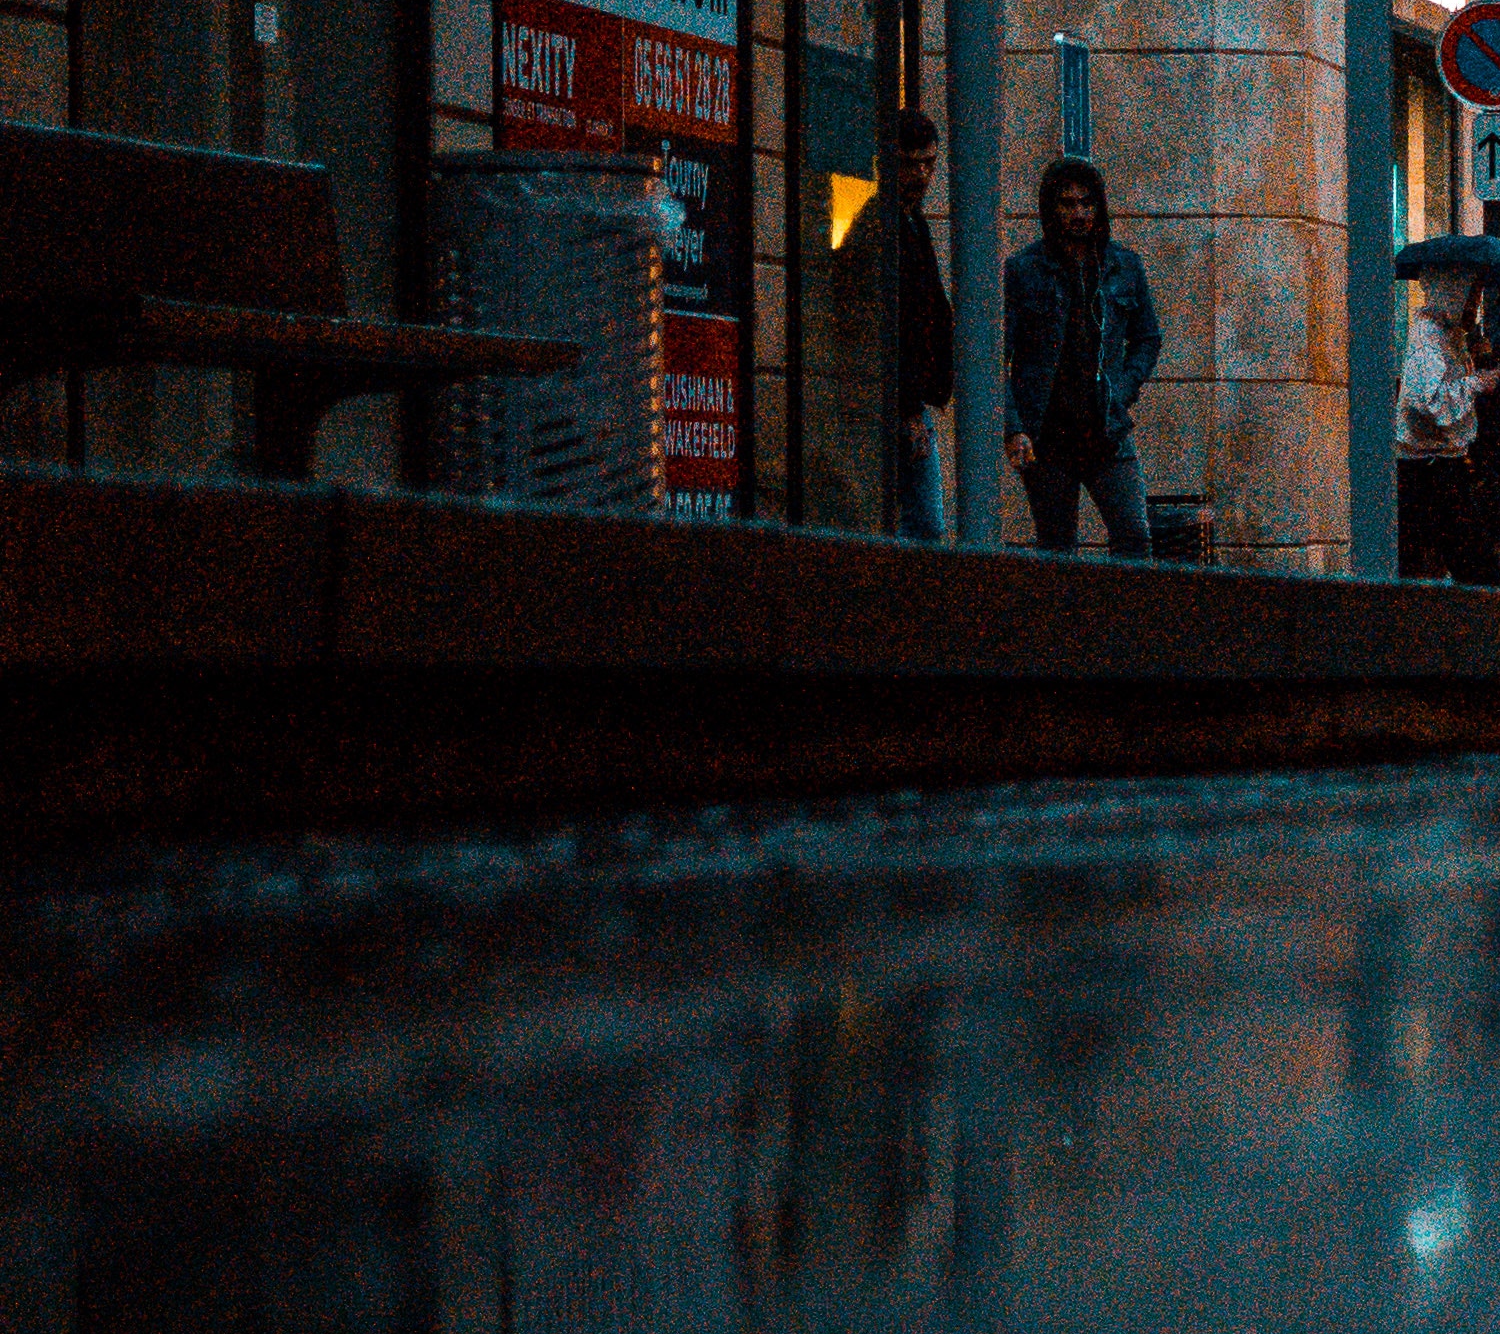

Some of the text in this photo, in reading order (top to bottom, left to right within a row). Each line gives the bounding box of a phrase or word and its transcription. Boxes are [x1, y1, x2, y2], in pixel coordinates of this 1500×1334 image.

[502, 20, 577, 100] NEXITY
[663, 227, 706, 273] eyer
[664, 372, 725, 412] CUSHMAN
[664, 420, 737, 460] WAKEFIELD
